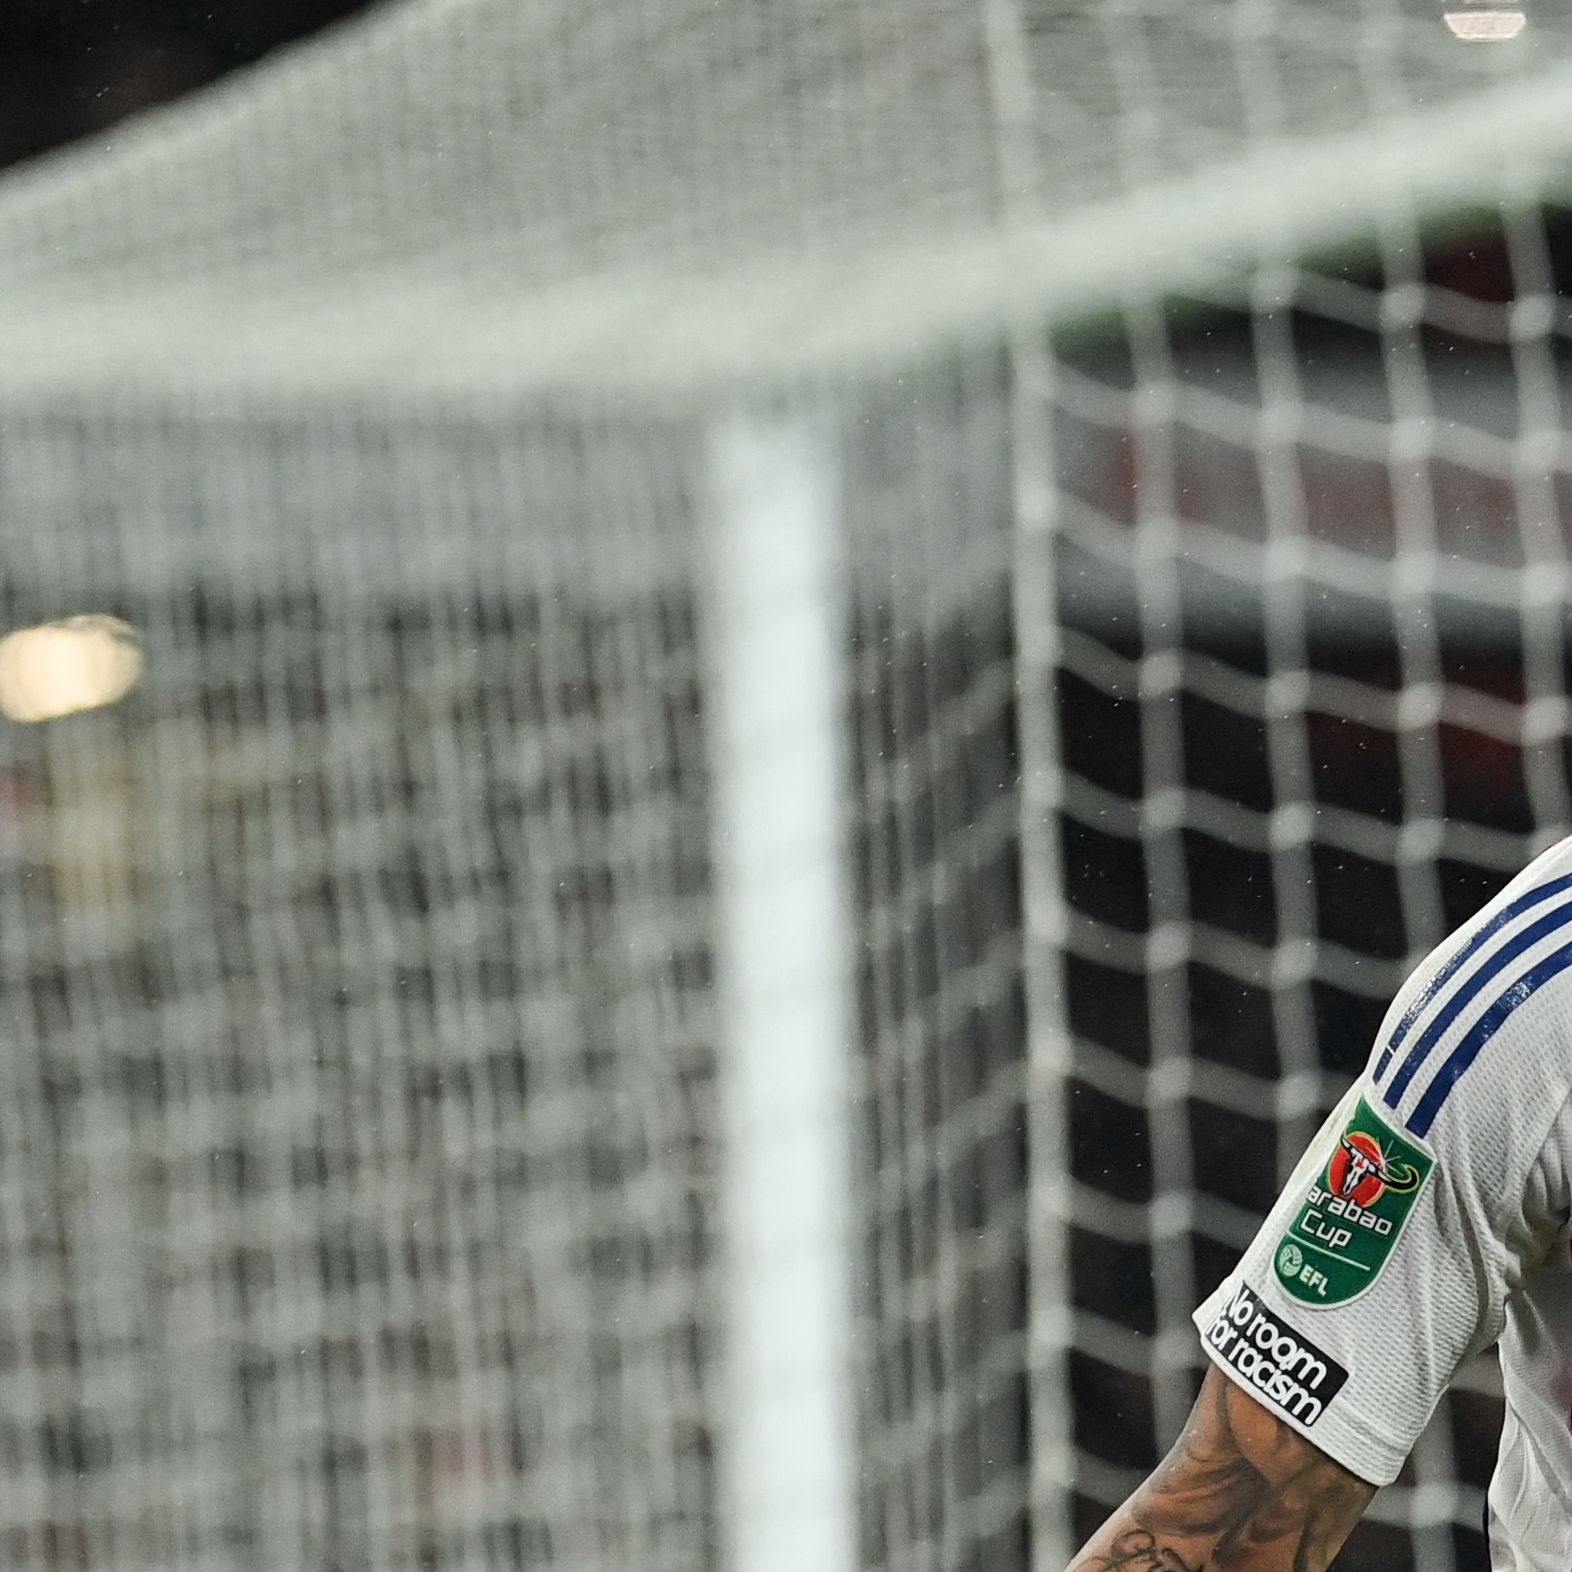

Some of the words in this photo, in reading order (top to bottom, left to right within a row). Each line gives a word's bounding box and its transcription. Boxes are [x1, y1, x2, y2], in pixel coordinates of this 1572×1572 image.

[1300, 1208, 1353, 1248] Cup
[1306, 1185, 1393, 1236] arabao
[1299, 1263, 1329, 1297] EFL
[1245, 1312, 1328, 1390] room
[1227, 1338, 1323, 1426] racism
